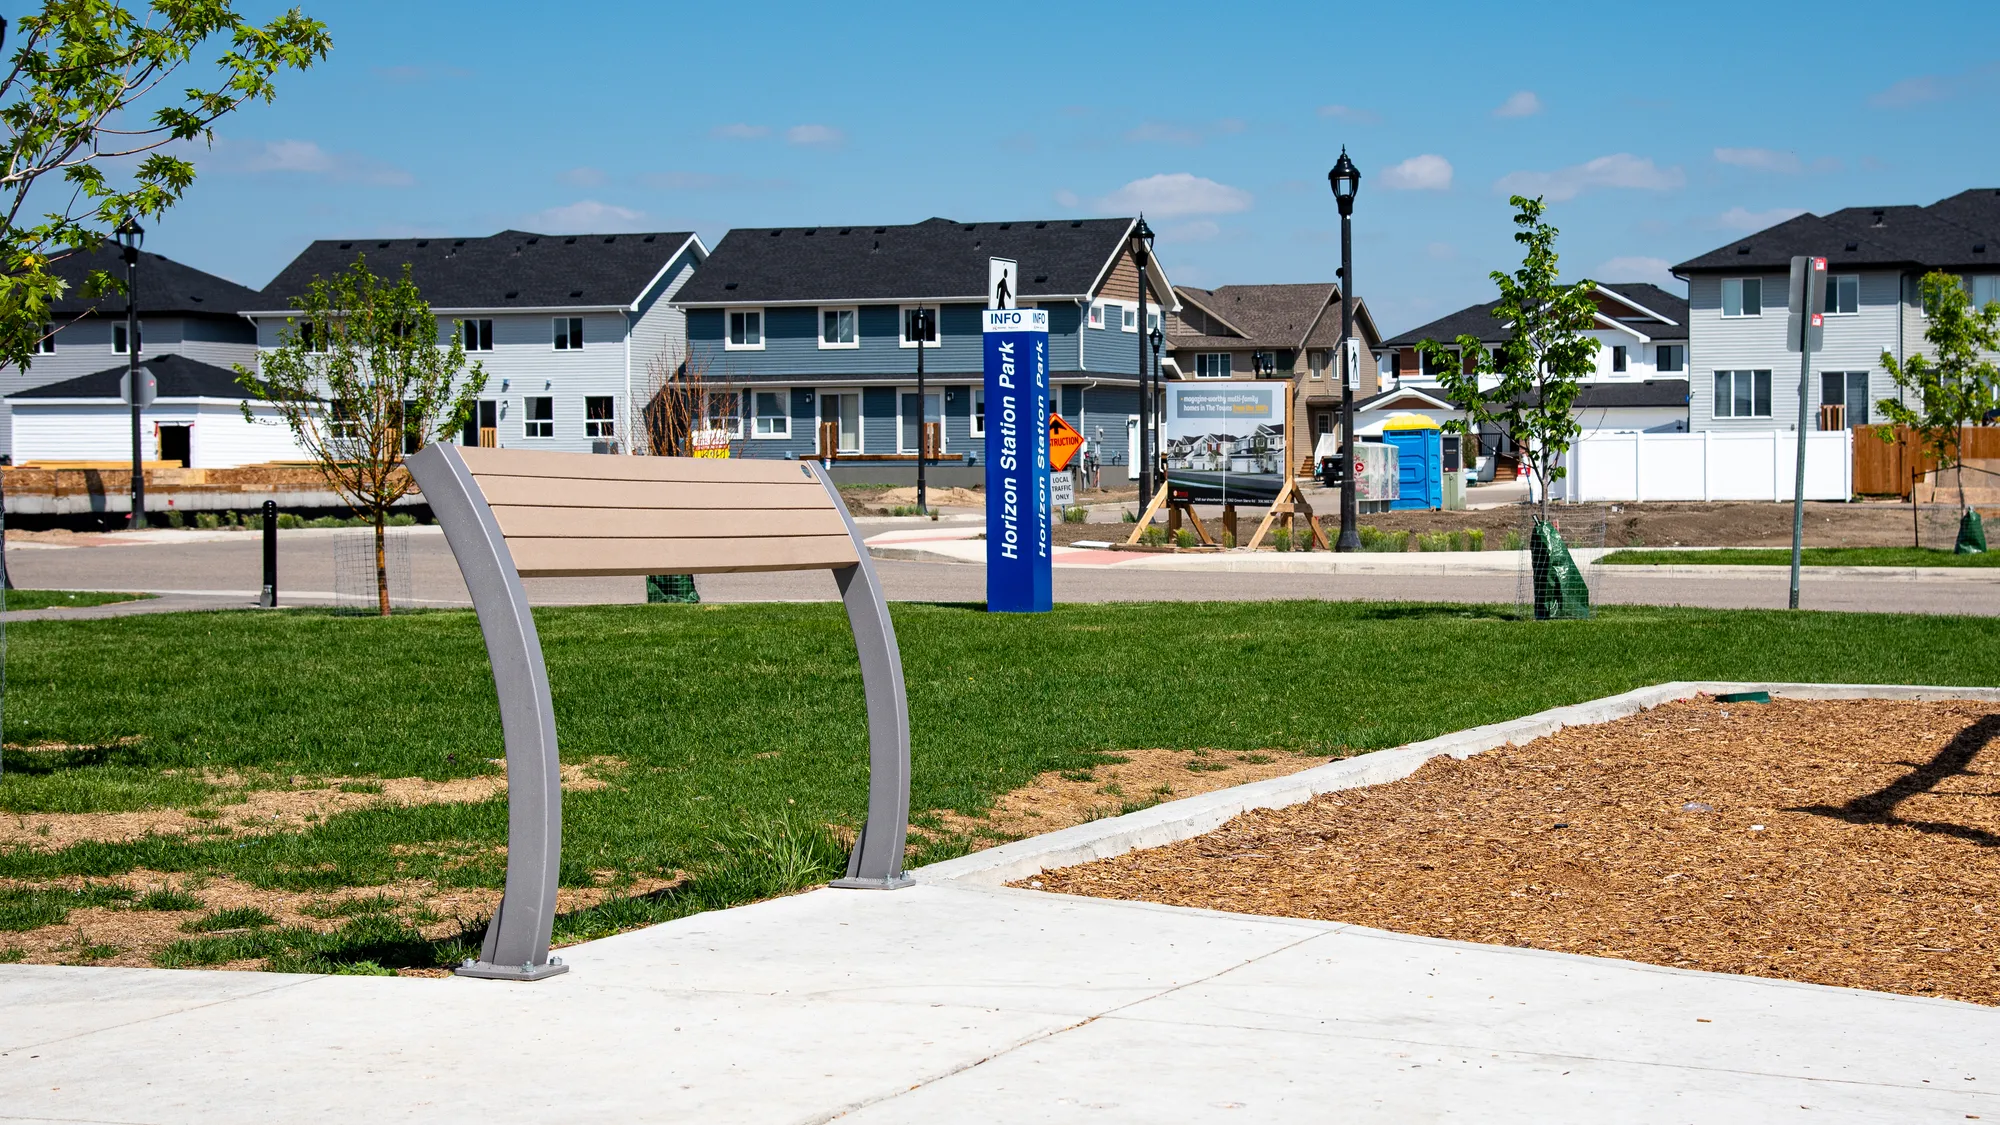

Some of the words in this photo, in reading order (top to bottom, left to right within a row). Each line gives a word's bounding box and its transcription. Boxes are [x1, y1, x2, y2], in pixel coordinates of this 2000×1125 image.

[990, 312, 1022, 325] INFO
[1032, 312, 1046, 325] INFO
[998, 341, 1014, 389] Park
[1036, 340, 1044, 389] Park
[1184, 404, 1199, 412] homes
[1206, 404, 1215, 412] The
[1000, 396, 1016, 470] Station
[1037, 394, 1045, 470] Station
[1050, 436, 1079, 447] TRUCTION
[1053, 476, 1069, 484] LOCAL
[1052, 484, 1072, 492] TRAFFIC
[1056, 493, 1069, 501] ONLY
[1001, 478, 1017, 559] Horizon
[1038, 476, 1046, 558] Horizon
